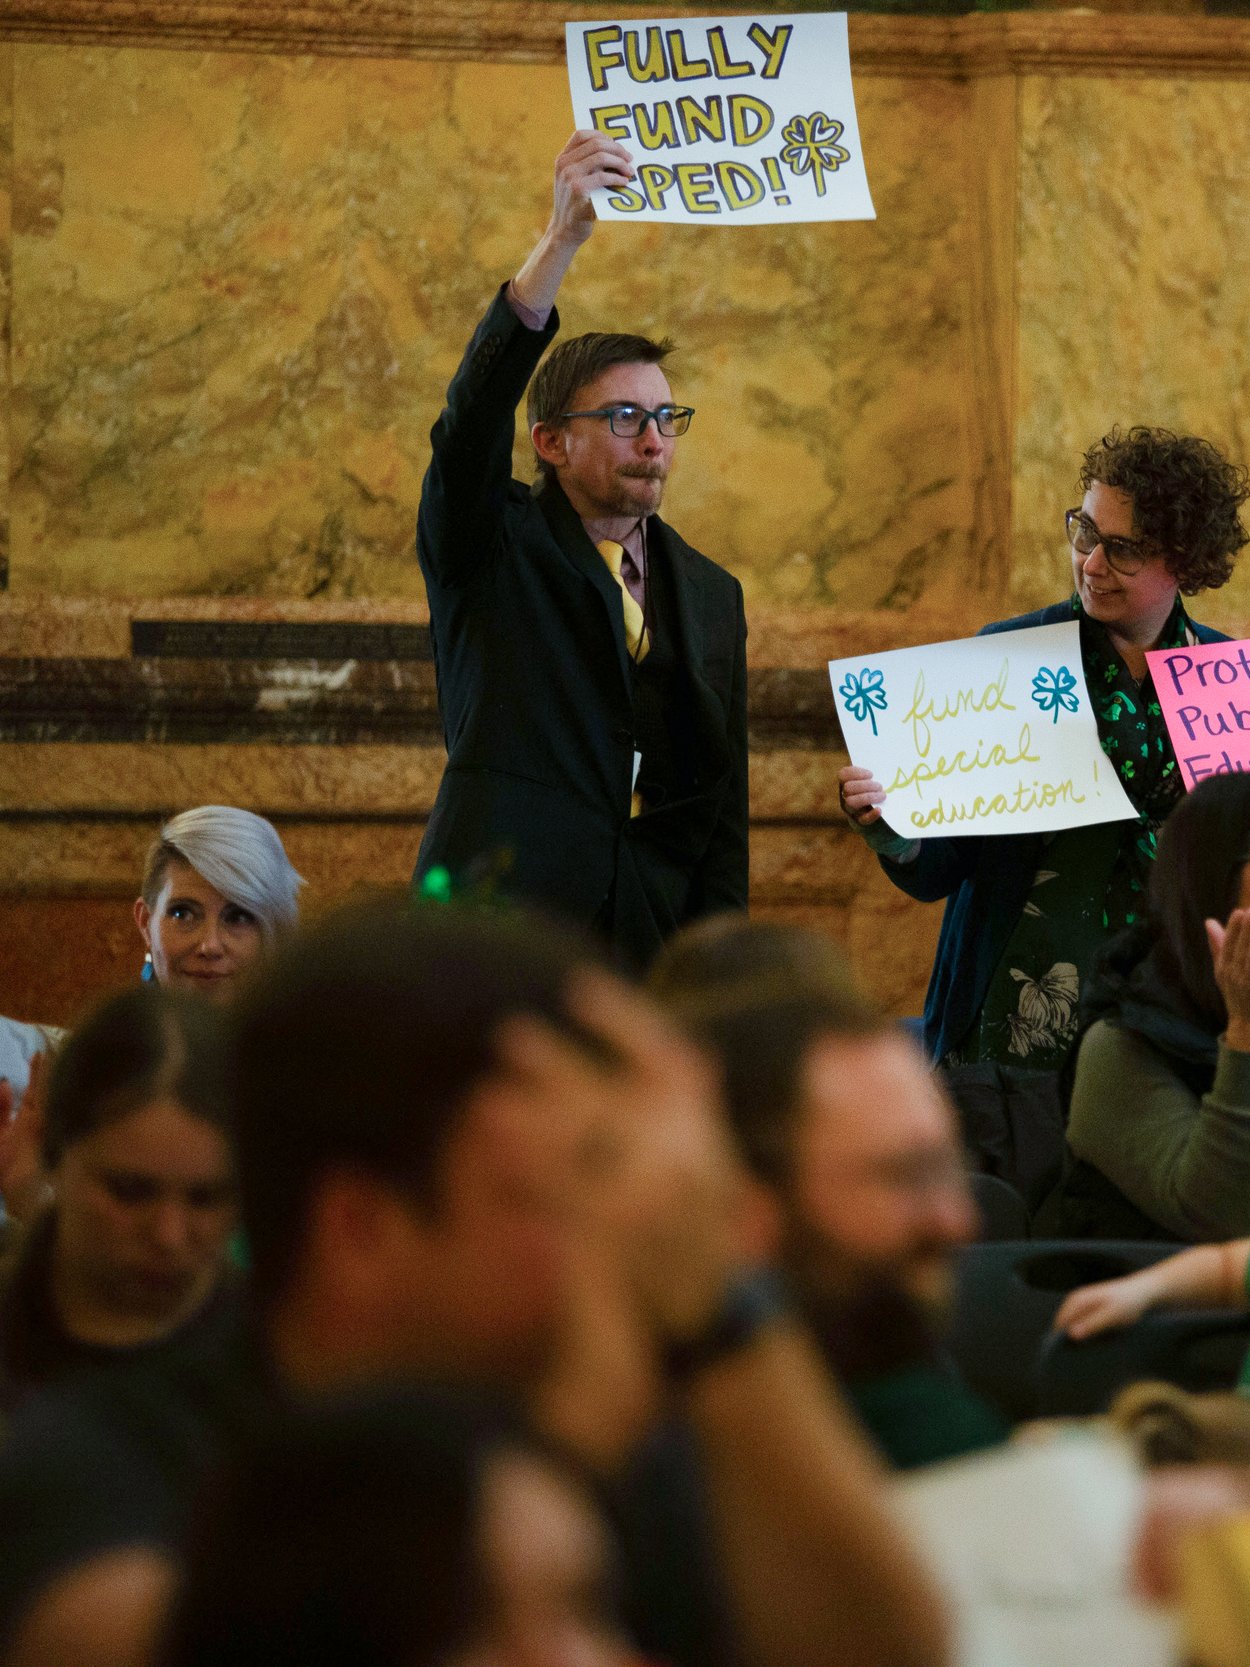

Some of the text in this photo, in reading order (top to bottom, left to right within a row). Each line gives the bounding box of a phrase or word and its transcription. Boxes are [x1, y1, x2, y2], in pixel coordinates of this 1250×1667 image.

[583, 22, 794, 92] FULLY
[589, 93, 774, 150] FUND
[604, 156, 791, 214] SPED!
[902, 656, 1016, 758] fund
[885, 722, 1041, 800] special
